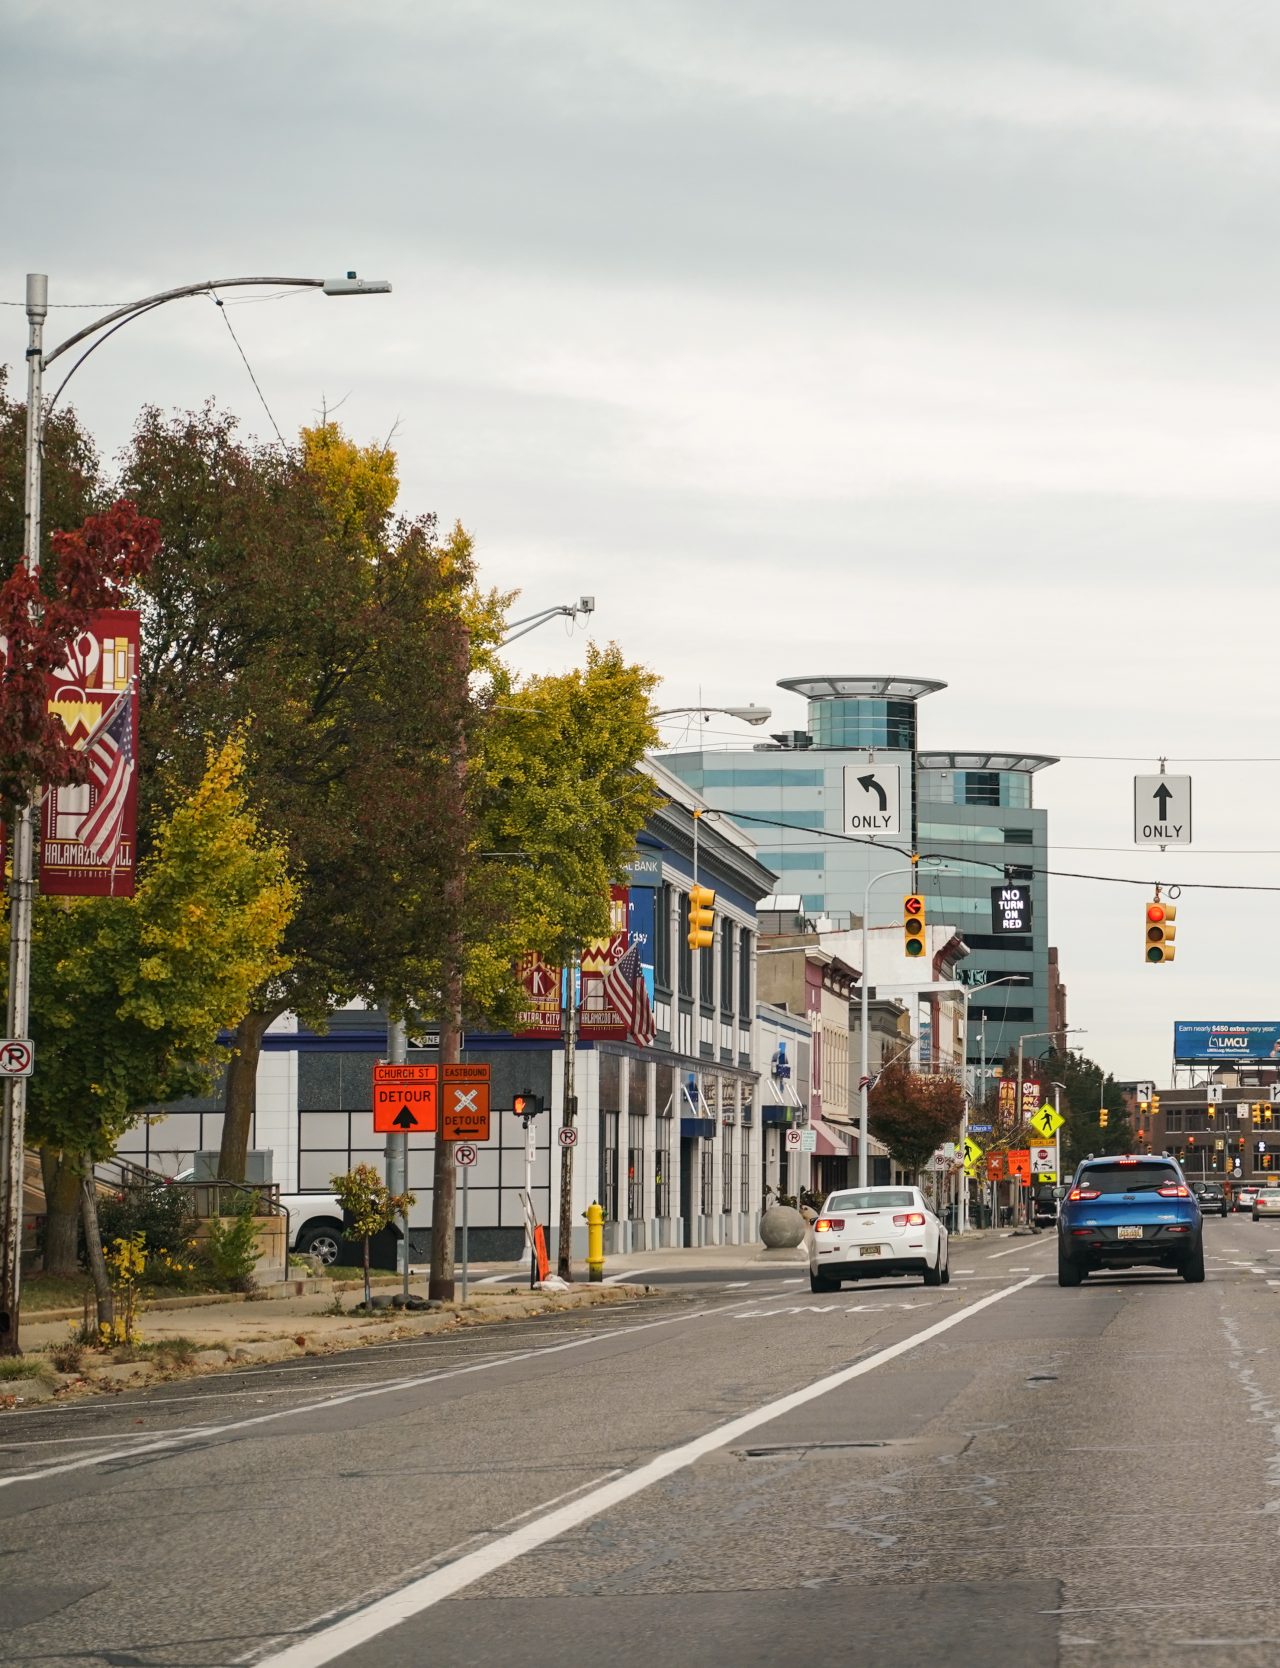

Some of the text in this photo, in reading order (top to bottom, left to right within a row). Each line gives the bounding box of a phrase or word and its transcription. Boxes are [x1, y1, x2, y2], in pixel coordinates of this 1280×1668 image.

[852, 815, 892, 829] ONLY
[1143, 824, 1183, 838] ONLY
[634, 860, 658, 872] BANK
[68, 870, 108, 878] DISTRICT
[1001, 889, 1020, 901] NO
[999, 901, 1024, 910] TURN
[1005, 911, 1019, 919] ON
[1003, 920, 1022, 929] RED
[545, 1012, 560, 1025] CITY
[1219, 1037, 1248, 1047] LMCU
[379, 1068, 430, 1079] CHURCH ST
[444, 1068, 488, 1077] EASTBOUND
[379, 1090, 432, 1103] DETOUR
[444, 1115, 487, 1126] DETOUR
